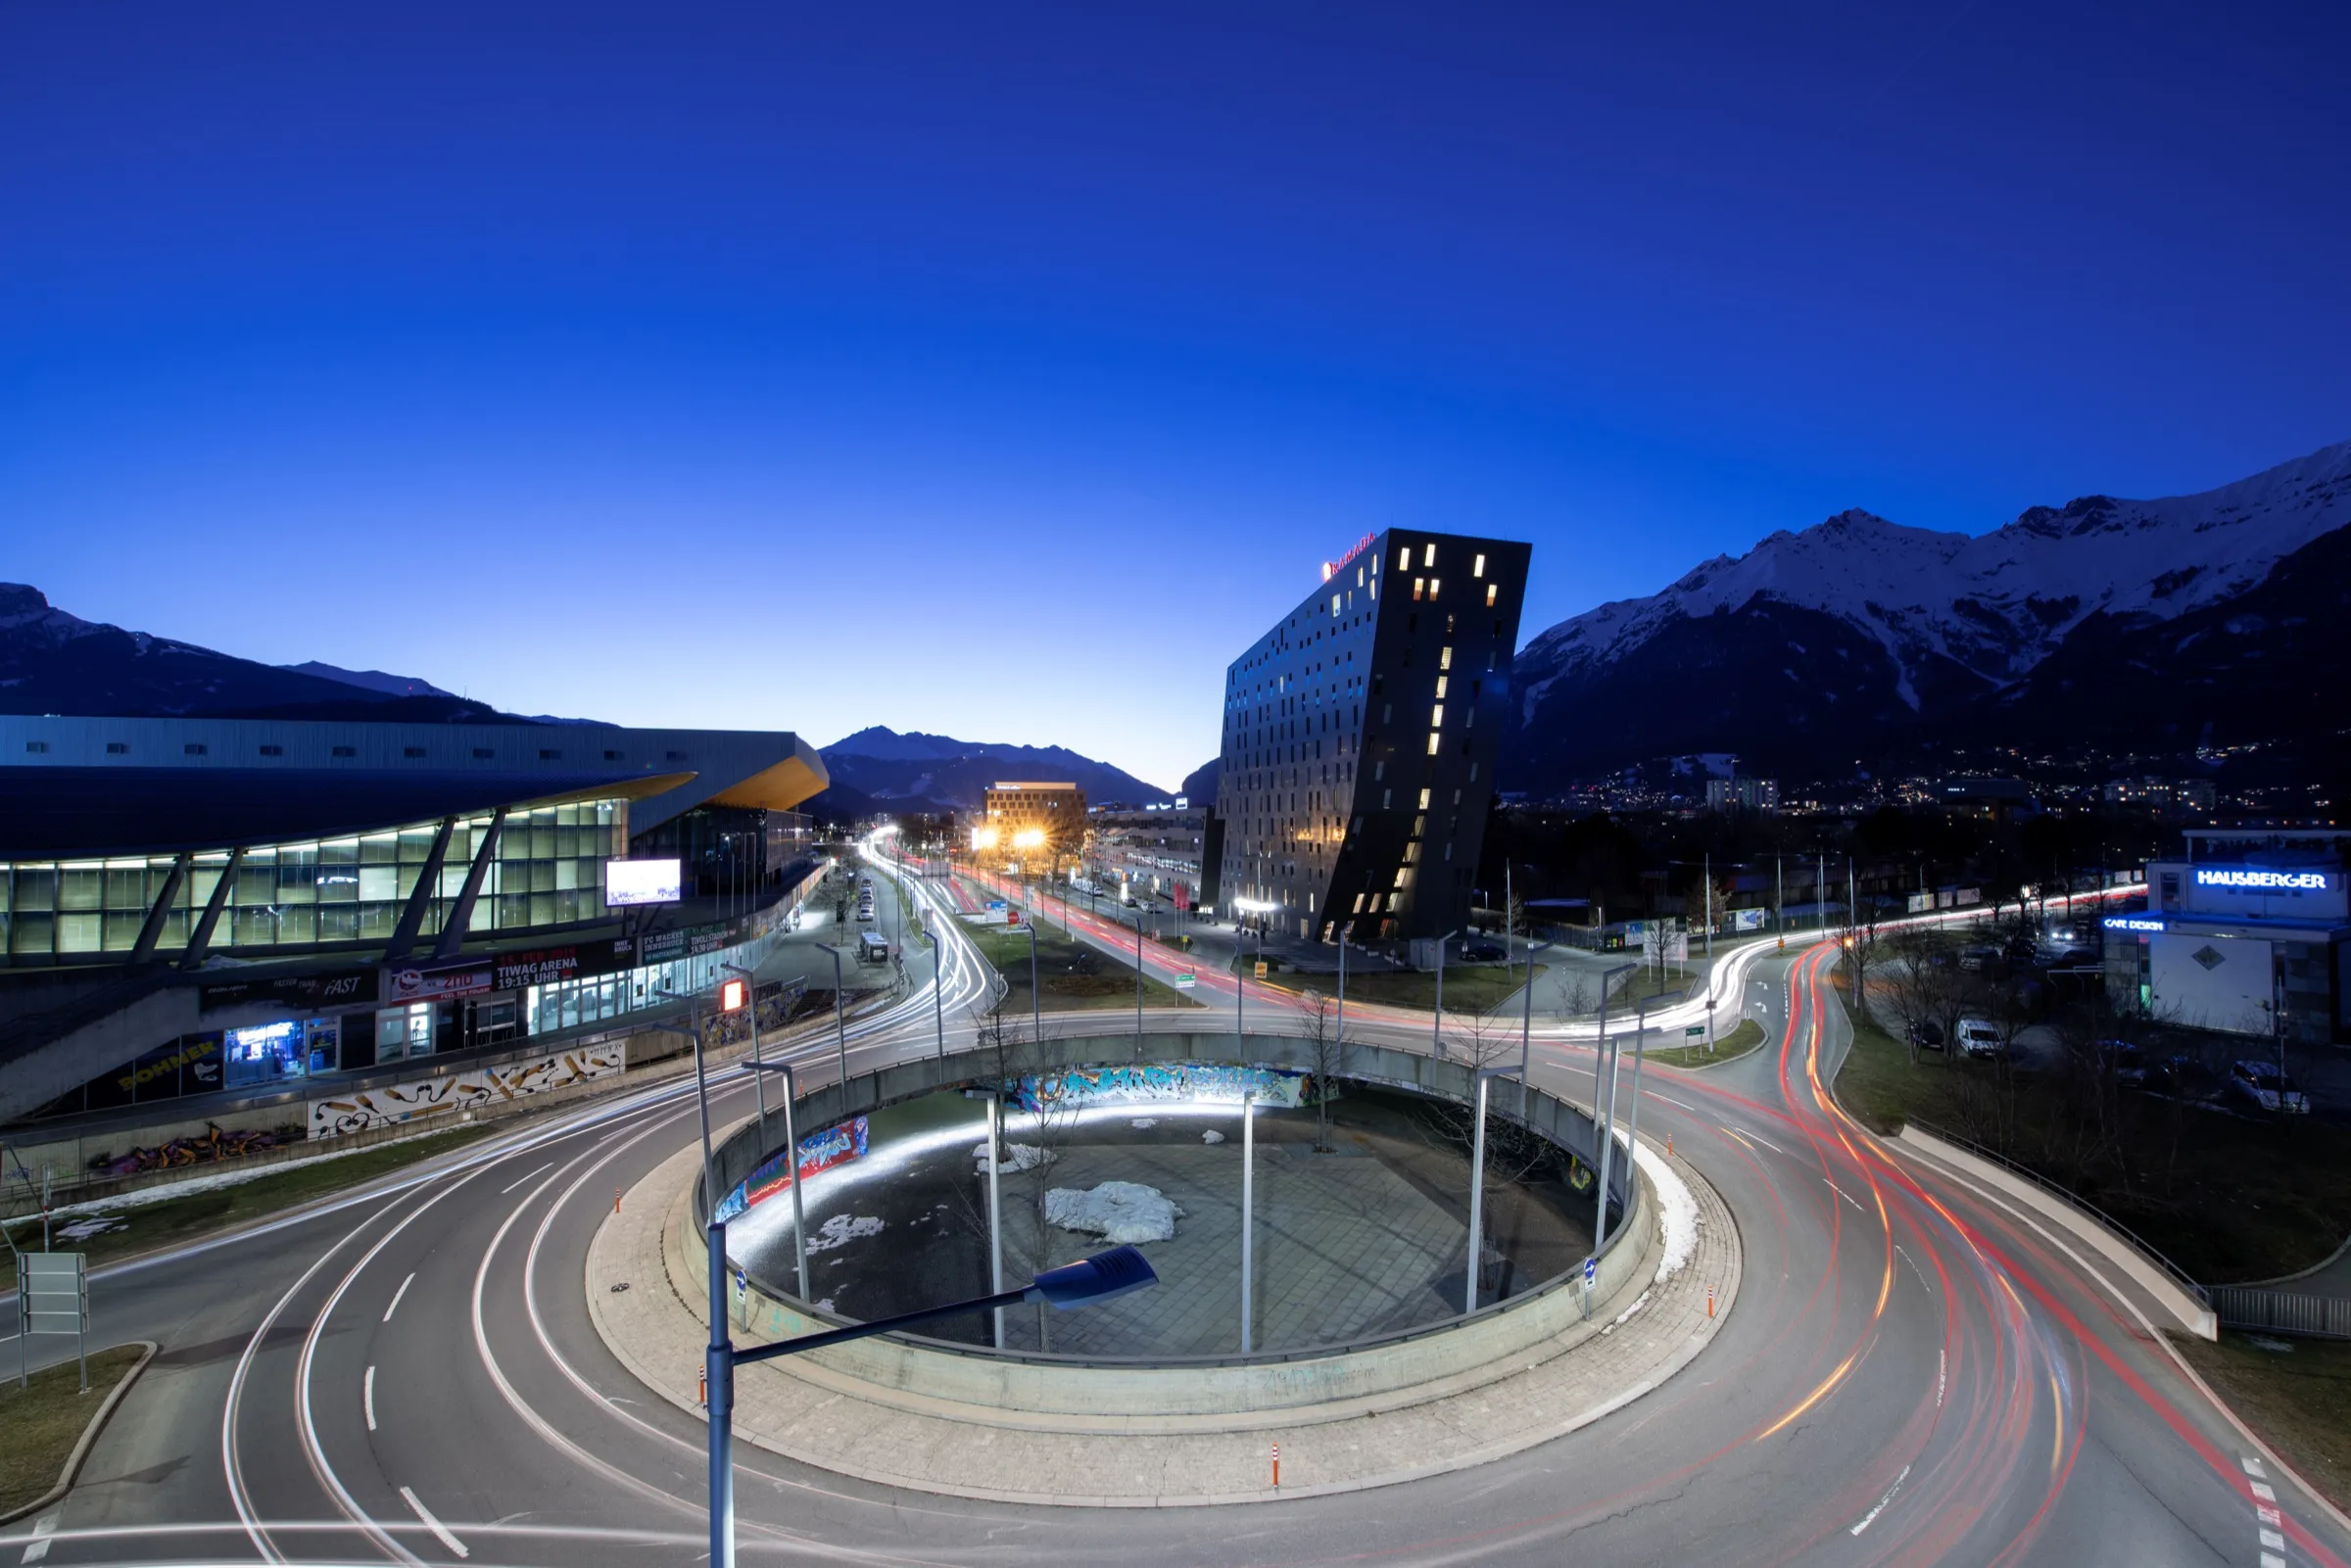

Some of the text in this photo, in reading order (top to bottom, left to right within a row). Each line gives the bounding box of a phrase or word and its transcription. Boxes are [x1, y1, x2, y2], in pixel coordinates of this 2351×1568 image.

[1331, 532, 1375, 575] RAMADA
[2197, 871, 2327, 889] HAUSBERGER
[2129, 920, 2165, 931] DESIGN
[655, 930, 684, 942] WACKER
[691, 933, 708, 946] TIVOLI
[708, 929, 729, 942] STADION
[614, 944, 633, 953] BRUCK
[644, 938, 684, 952] INNSBRUCK
[498, 957, 578, 978] TIWAG ARENA
[273, 977, 298, 989] FASTER
[324, 975, 361, 996] FAST
[498, 974, 531, 989] 19:15
[535, 971, 559, 984] UHR
